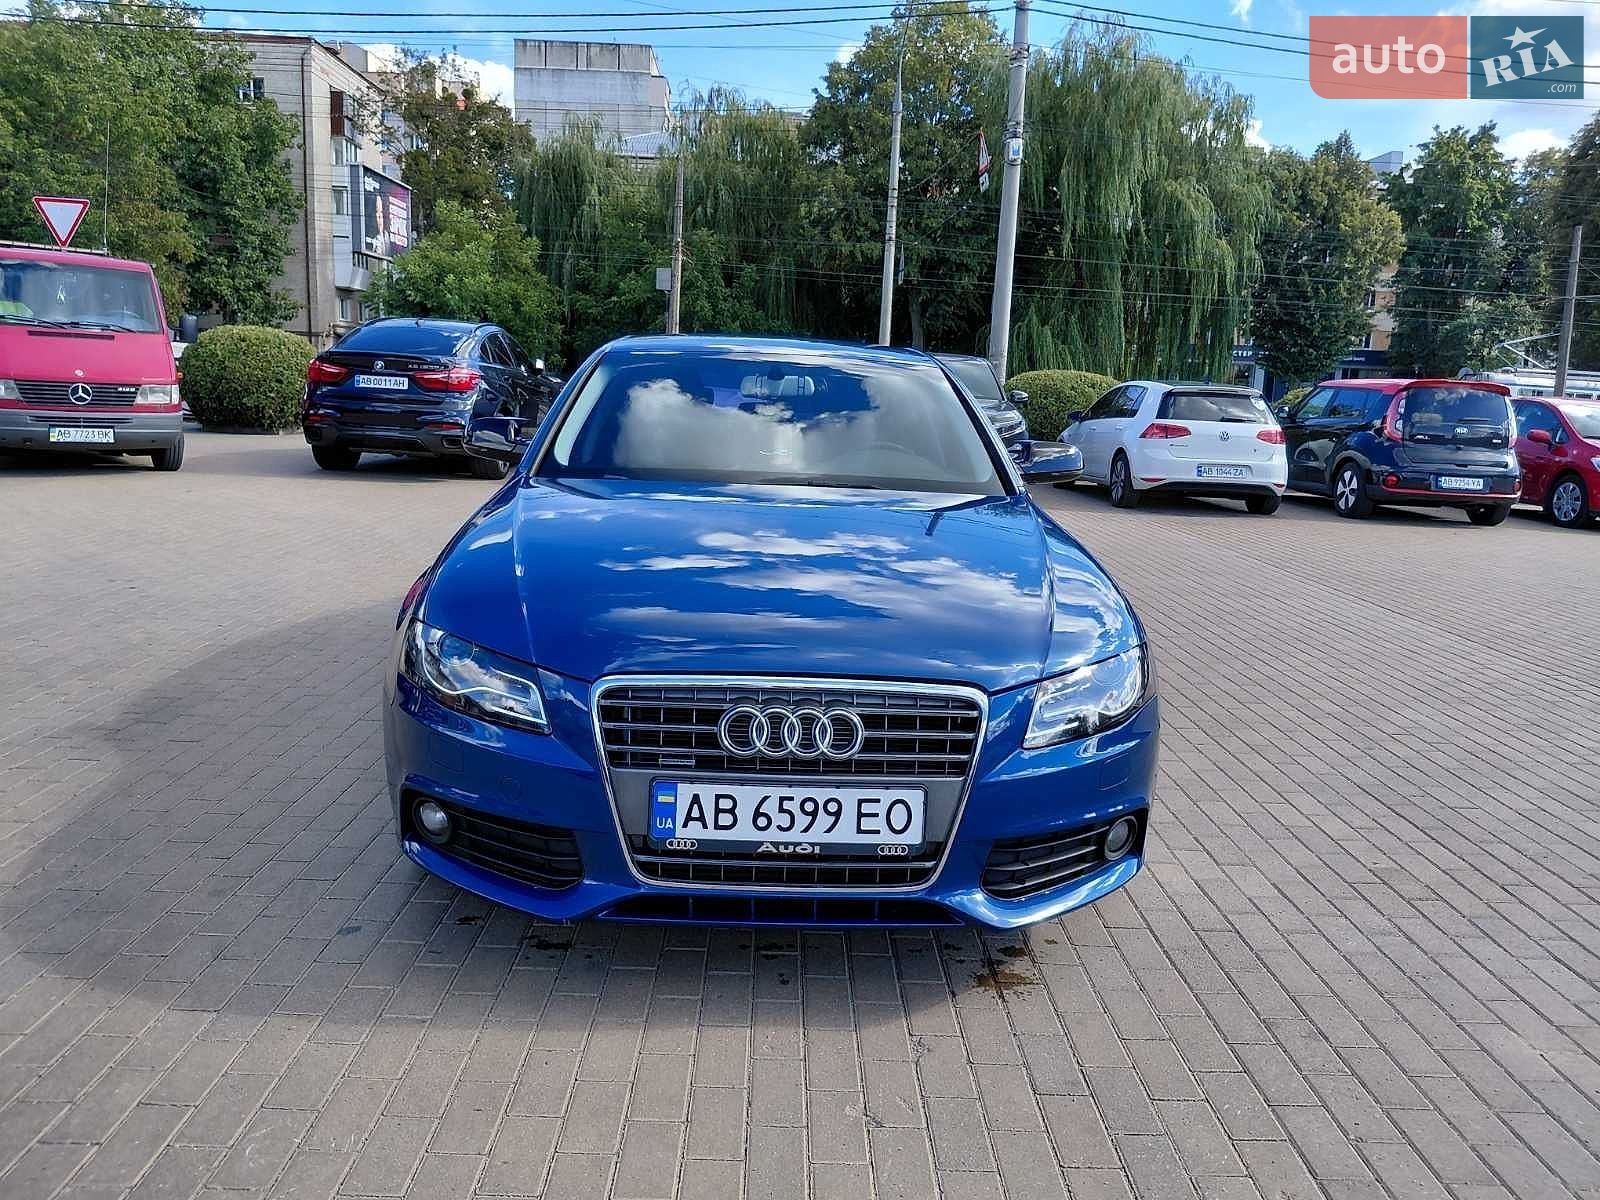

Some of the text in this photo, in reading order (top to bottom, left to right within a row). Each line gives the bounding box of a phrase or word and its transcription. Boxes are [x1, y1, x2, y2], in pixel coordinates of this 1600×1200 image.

[360, 376, 405, 388] AB 0011 AH
[57, 429, 112, 440] AB 7723 BK
[1203, 467, 1213, 475] AB
[1443, 478, 1453, 486] AB
[681, 793, 912, 835] AB 6599 EO
[656, 817, 673, 829] UA
[756, 841, 821, 854] Audi
